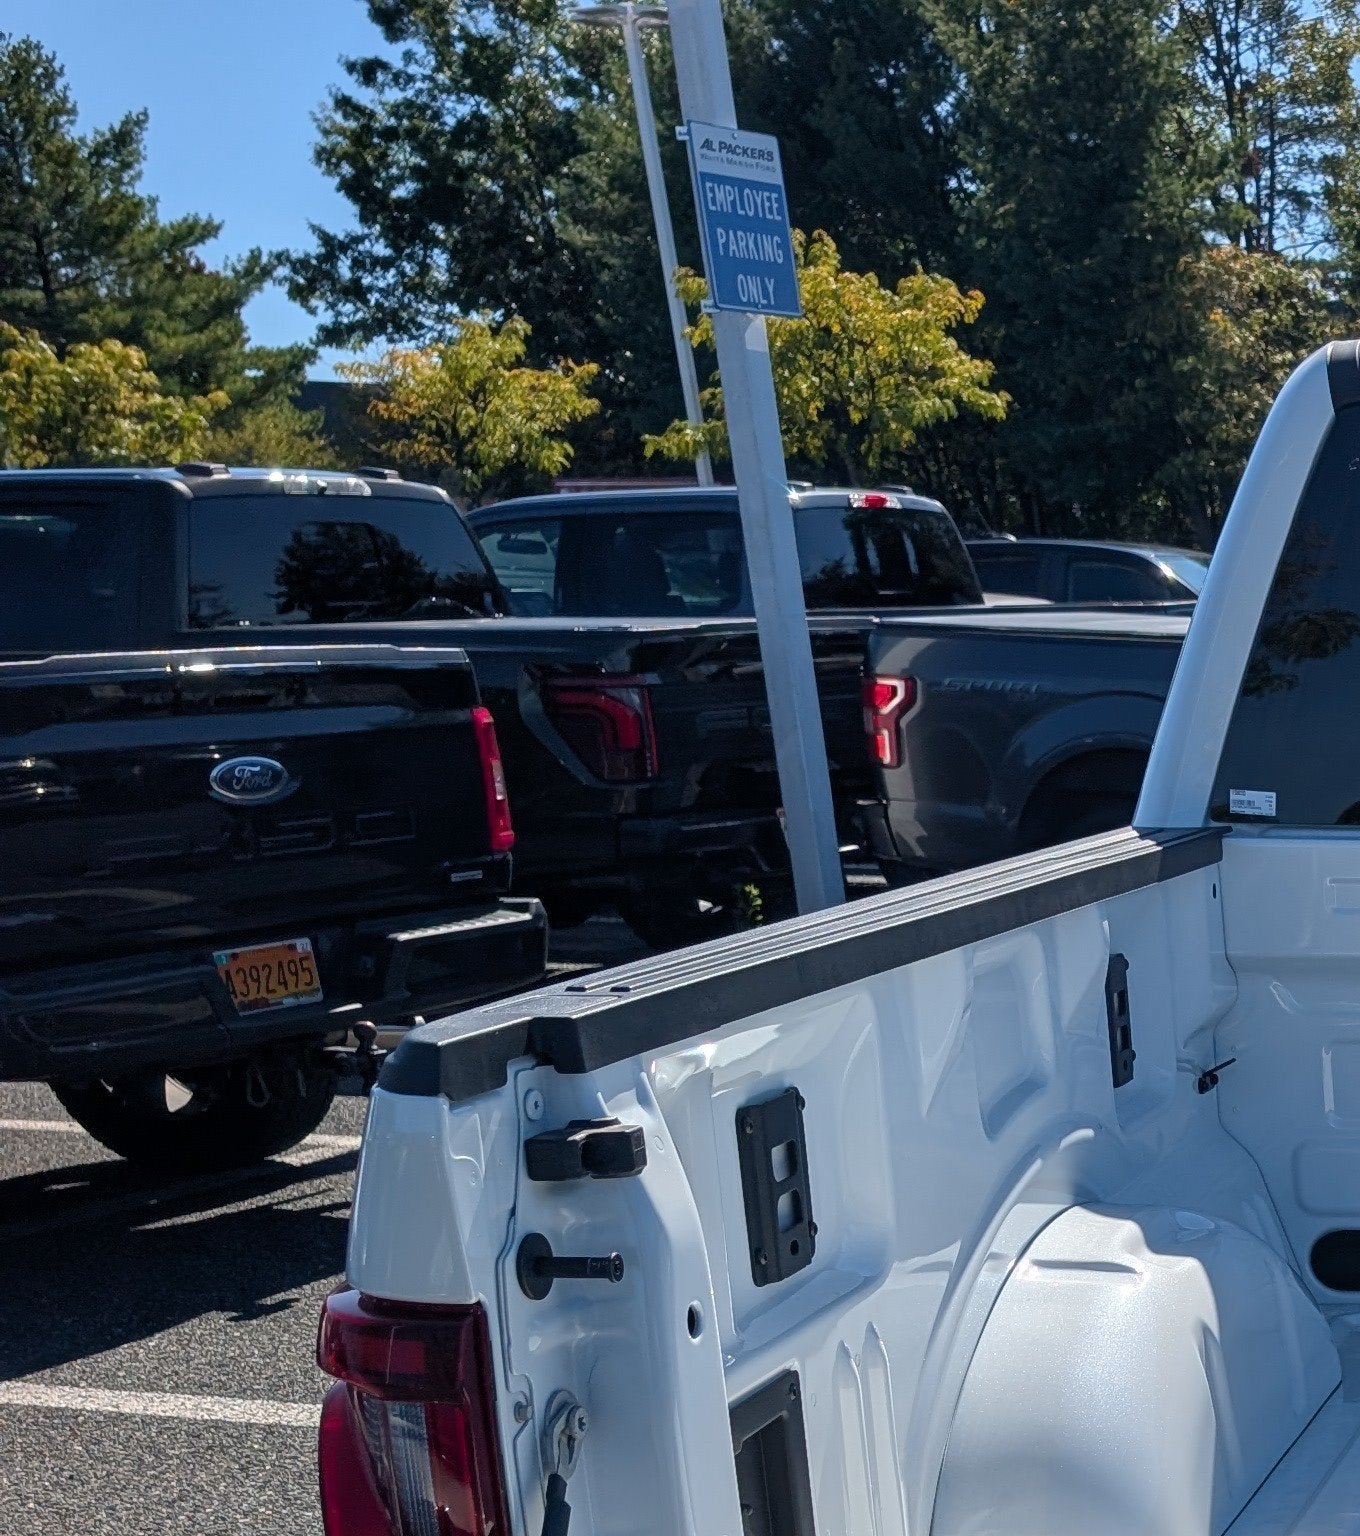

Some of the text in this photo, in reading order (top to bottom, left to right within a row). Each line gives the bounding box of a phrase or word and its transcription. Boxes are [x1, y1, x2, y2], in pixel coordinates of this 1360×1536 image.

[700, 138, 716, 152] AL
[705, 182, 782, 221] EMPLOYEE
[716, 227, 783, 264] PARKING
[737, 274, 776, 305] ONLY
[233, 765, 273, 790] Ford
